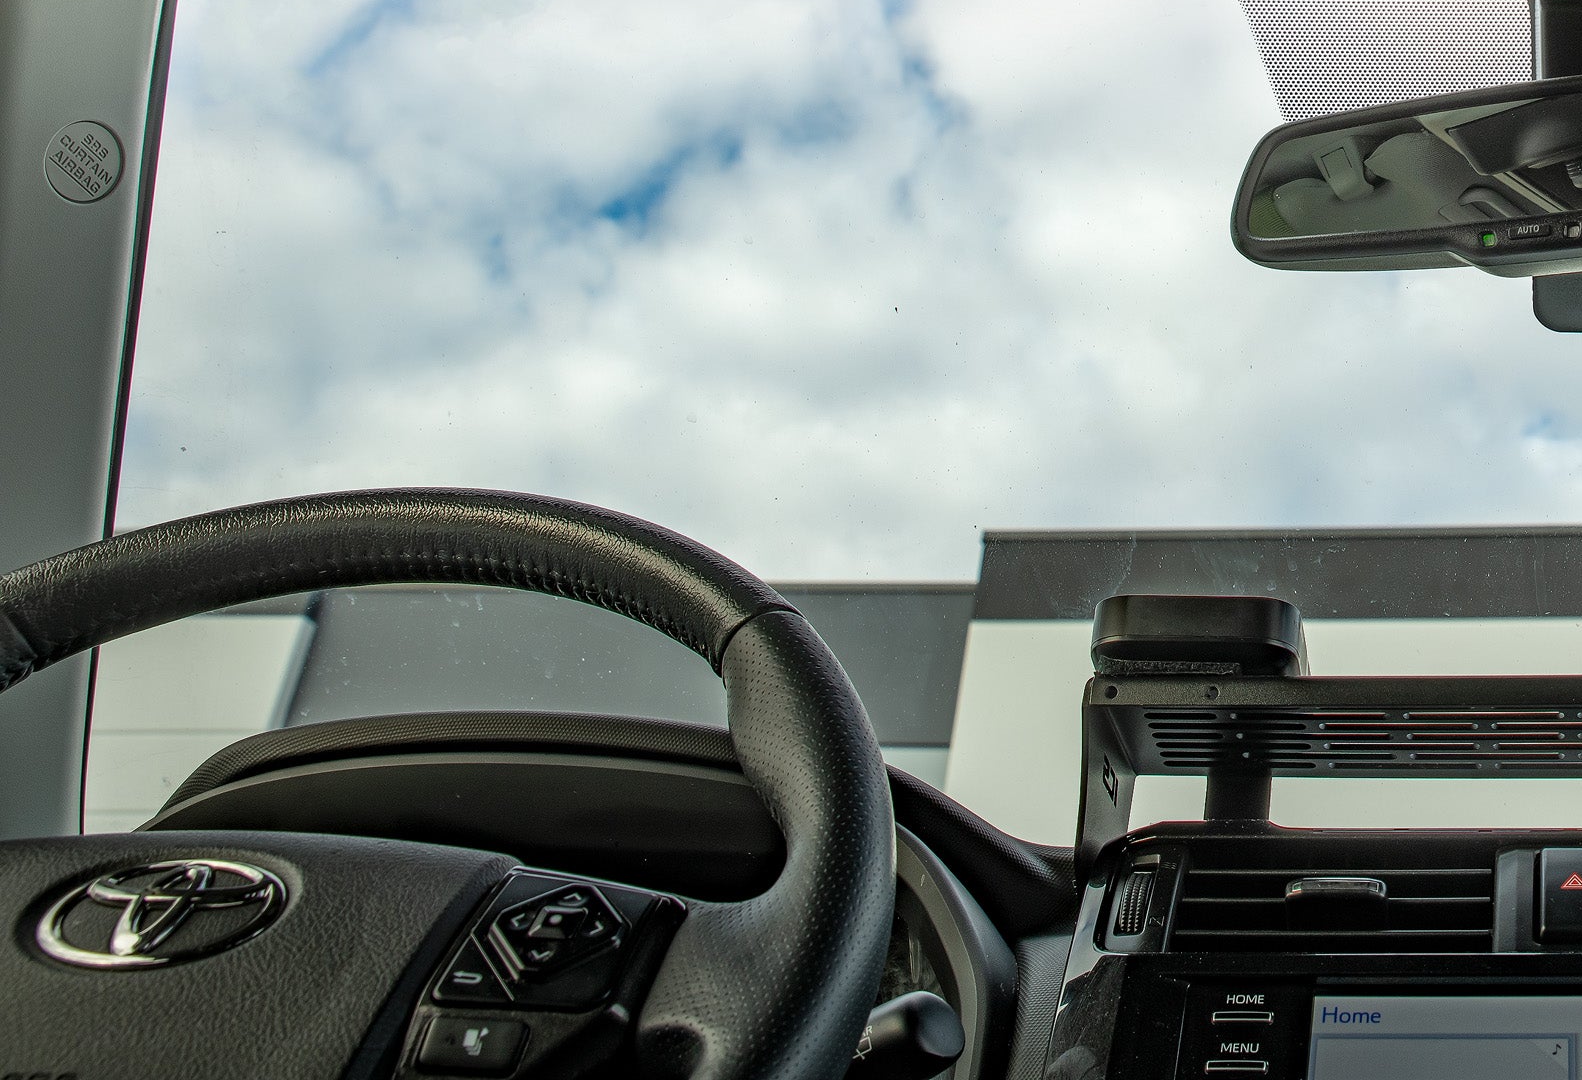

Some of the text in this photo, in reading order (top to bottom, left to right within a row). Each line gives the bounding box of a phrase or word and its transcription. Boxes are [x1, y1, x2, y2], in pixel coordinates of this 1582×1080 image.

[83, 133, 109, 159] SRS
[60, 134, 113, 185] CURTAIN
[52, 150, 101, 194] AIRBAG
[1517, 224, 1540, 235] AUTO
[1226, 994, 1265, 1005] HOME
[1321, 1006, 1382, 1024] Home
[1220, 1043, 1260, 1054] MENU
